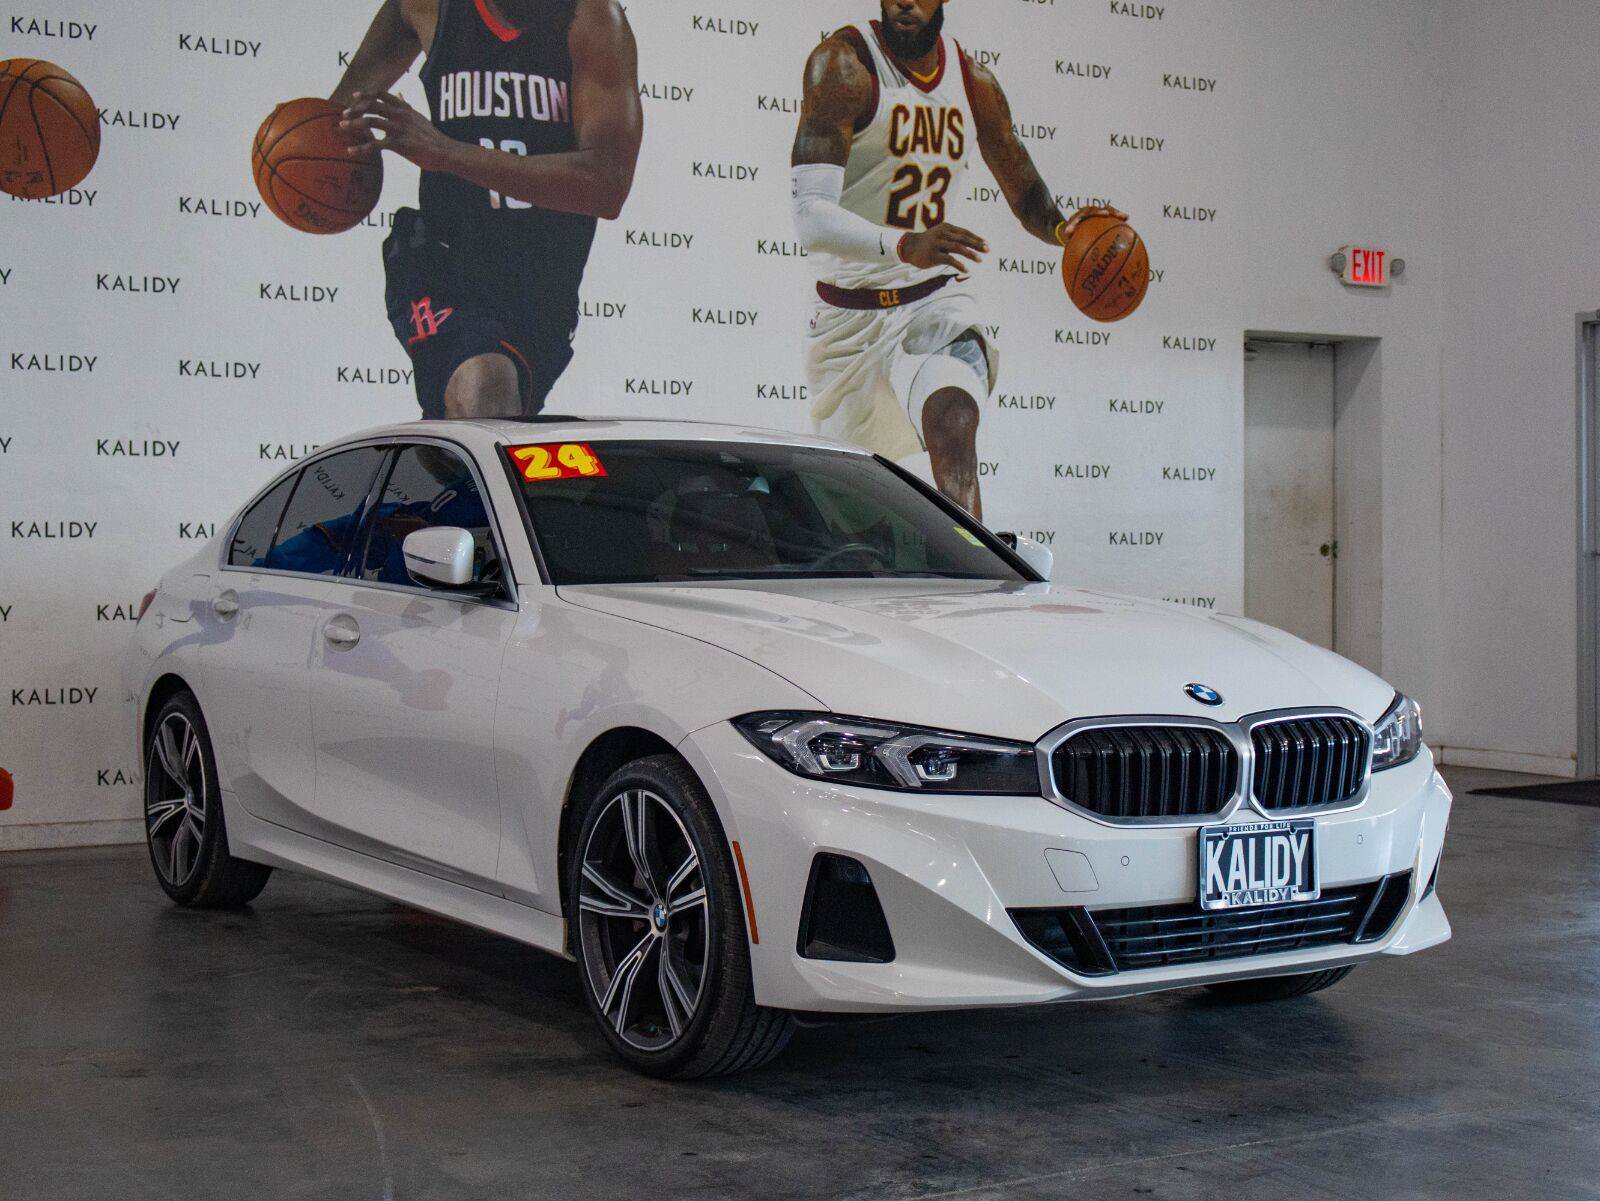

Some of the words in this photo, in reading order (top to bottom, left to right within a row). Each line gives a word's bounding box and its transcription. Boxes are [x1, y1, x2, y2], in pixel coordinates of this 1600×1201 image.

[1111, 1, 1164, 20] KALIDY
[12, 16, 97, 40] KALIDY
[693, 16, 759, 36] KALIDY
[179, 34, 261, 57] KALIDY
[965, 49, 1000, 65] IDY
[1056, 60, 1111, 79] KALIDY
[1164, 74, 1216, 92] KALIDY
[440, 70, 569, 123] HOUSTON
[639, 83, 693, 102] ALIDY
[757, 95, 804, 113] KALI
[97, 107, 180, 130] KALIDY
[889, 103, 965, 162] CAVS
[1011, 124, 1056, 140] ALIDY
[1110, 134, 1164, 151] KALIDY
[693, 162, 758, 181] KALIDY
[886, 163, 954, 232] 23
[965, 187, 1000, 203] IDY
[179, 197, 261, 218] KALIDY
[1163, 205, 1216, 221] KALIDY
[626, 230, 693, 248] KALIDY
[999, 258, 1056, 275] KALIDY
[1352, 249, 1386, 285] EXIT
[97, 274, 180, 294] KALIDY
[260, 283, 338, 303] KALIDY
[577, 301, 626, 318] LIDY
[692, 308, 757, 325] KALIDY
[1055, 329, 1110, 345] KALIDY
[1163, 336, 1216, 351] KALIDY
[12, 353, 97, 372] KALIDY
[180, 360, 260, 379] KALIDY
[338, 366, 413, 384] KALIDY
[626, 379, 693, 395] KALIDY
[999, 394, 1055, 410] KALIDY
[1109, 399, 1163, 413] KALIDY
[97, 439, 180, 457] KALIDY
[260, 443, 321, 459] KALI
[513, 443, 600, 479] 24
[1055, 464, 1110, 478] KALIDY
[1163, 467, 1215, 480] KALIDY
[12, 521, 97, 538] KALIDY
[1109, 532, 1163, 545] KALIDY
[97, 603, 138, 621] KAL
[12, 687, 98, 705] KALIDY
[1260, 823, 1273, 831] FOR
[1275, 821, 1290, 830] LIFE
[1206, 833, 1309, 894] KALIDY
[1231, 887, 1288, 905] KALIDY
